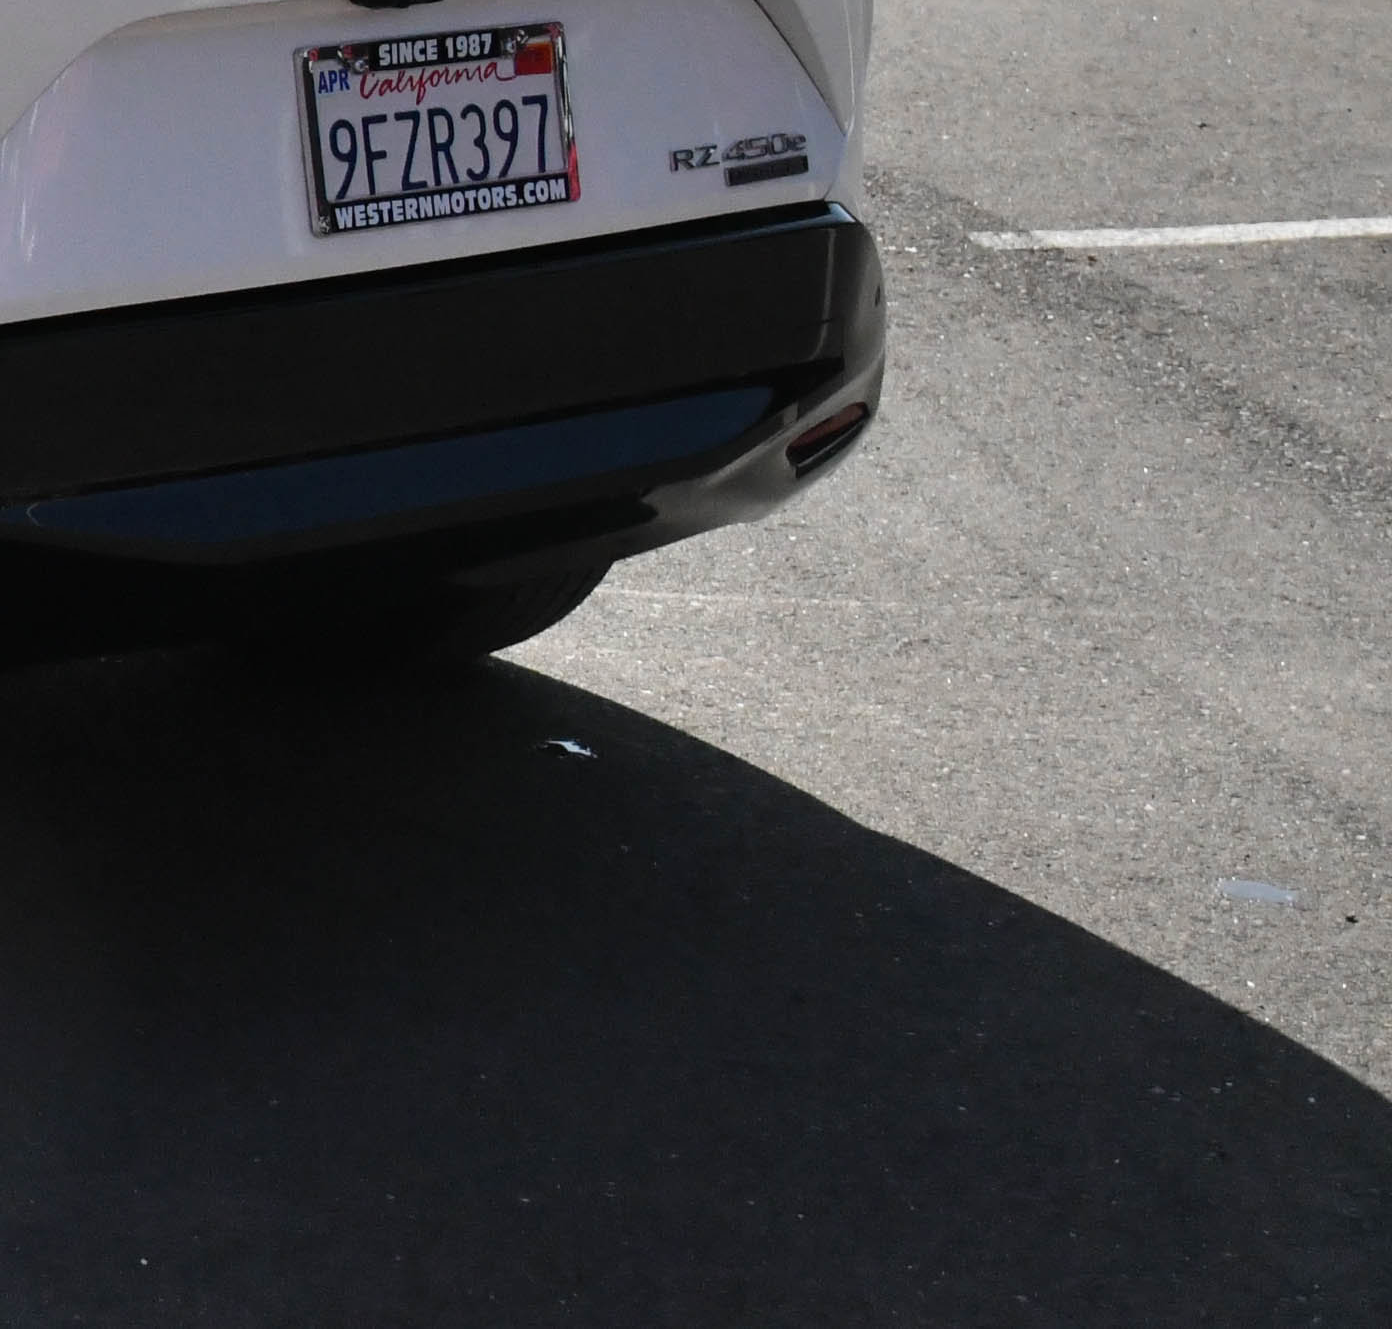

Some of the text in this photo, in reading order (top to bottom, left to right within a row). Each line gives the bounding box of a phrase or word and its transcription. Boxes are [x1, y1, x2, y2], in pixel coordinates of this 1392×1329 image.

[378, 37, 438, 67] SINCE
[445, 32, 492, 59] 1987
[318, 69, 350, 94] APR
[359, 61, 516, 105] California
[328, 94, 548, 200] 9FZR397
[669, 143, 720, 173] RZ
[722, 133, 807, 162] 450e
[334, 178, 566, 230] WESTERNMOTORS.COM
